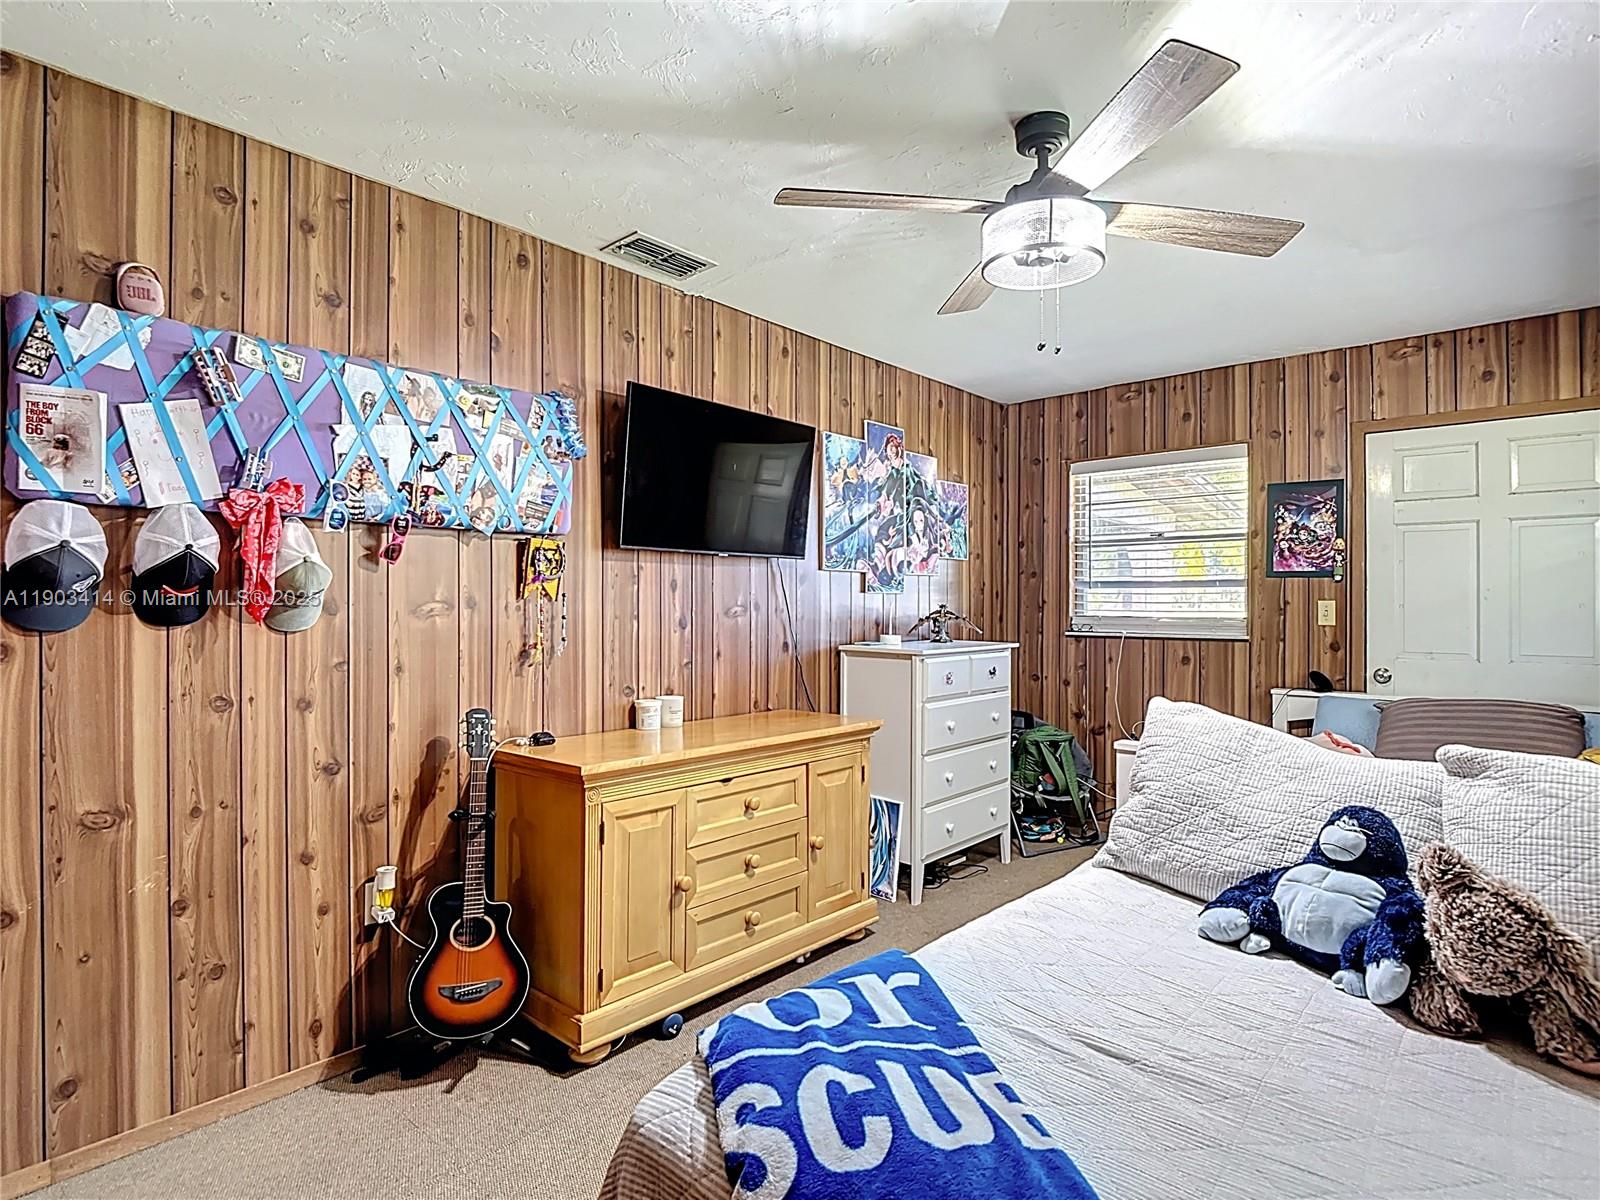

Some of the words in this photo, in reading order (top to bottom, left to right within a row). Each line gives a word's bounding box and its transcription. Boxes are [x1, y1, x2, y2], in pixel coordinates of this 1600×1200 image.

[126, 284, 156, 302] JBL
[25, 400, 42, 410] THE
[42, 402, 59, 411] BOY
[25, 408, 49, 417] FROM
[25, 415, 53, 425] BLOCK
[25, 423, 44, 436] 66
